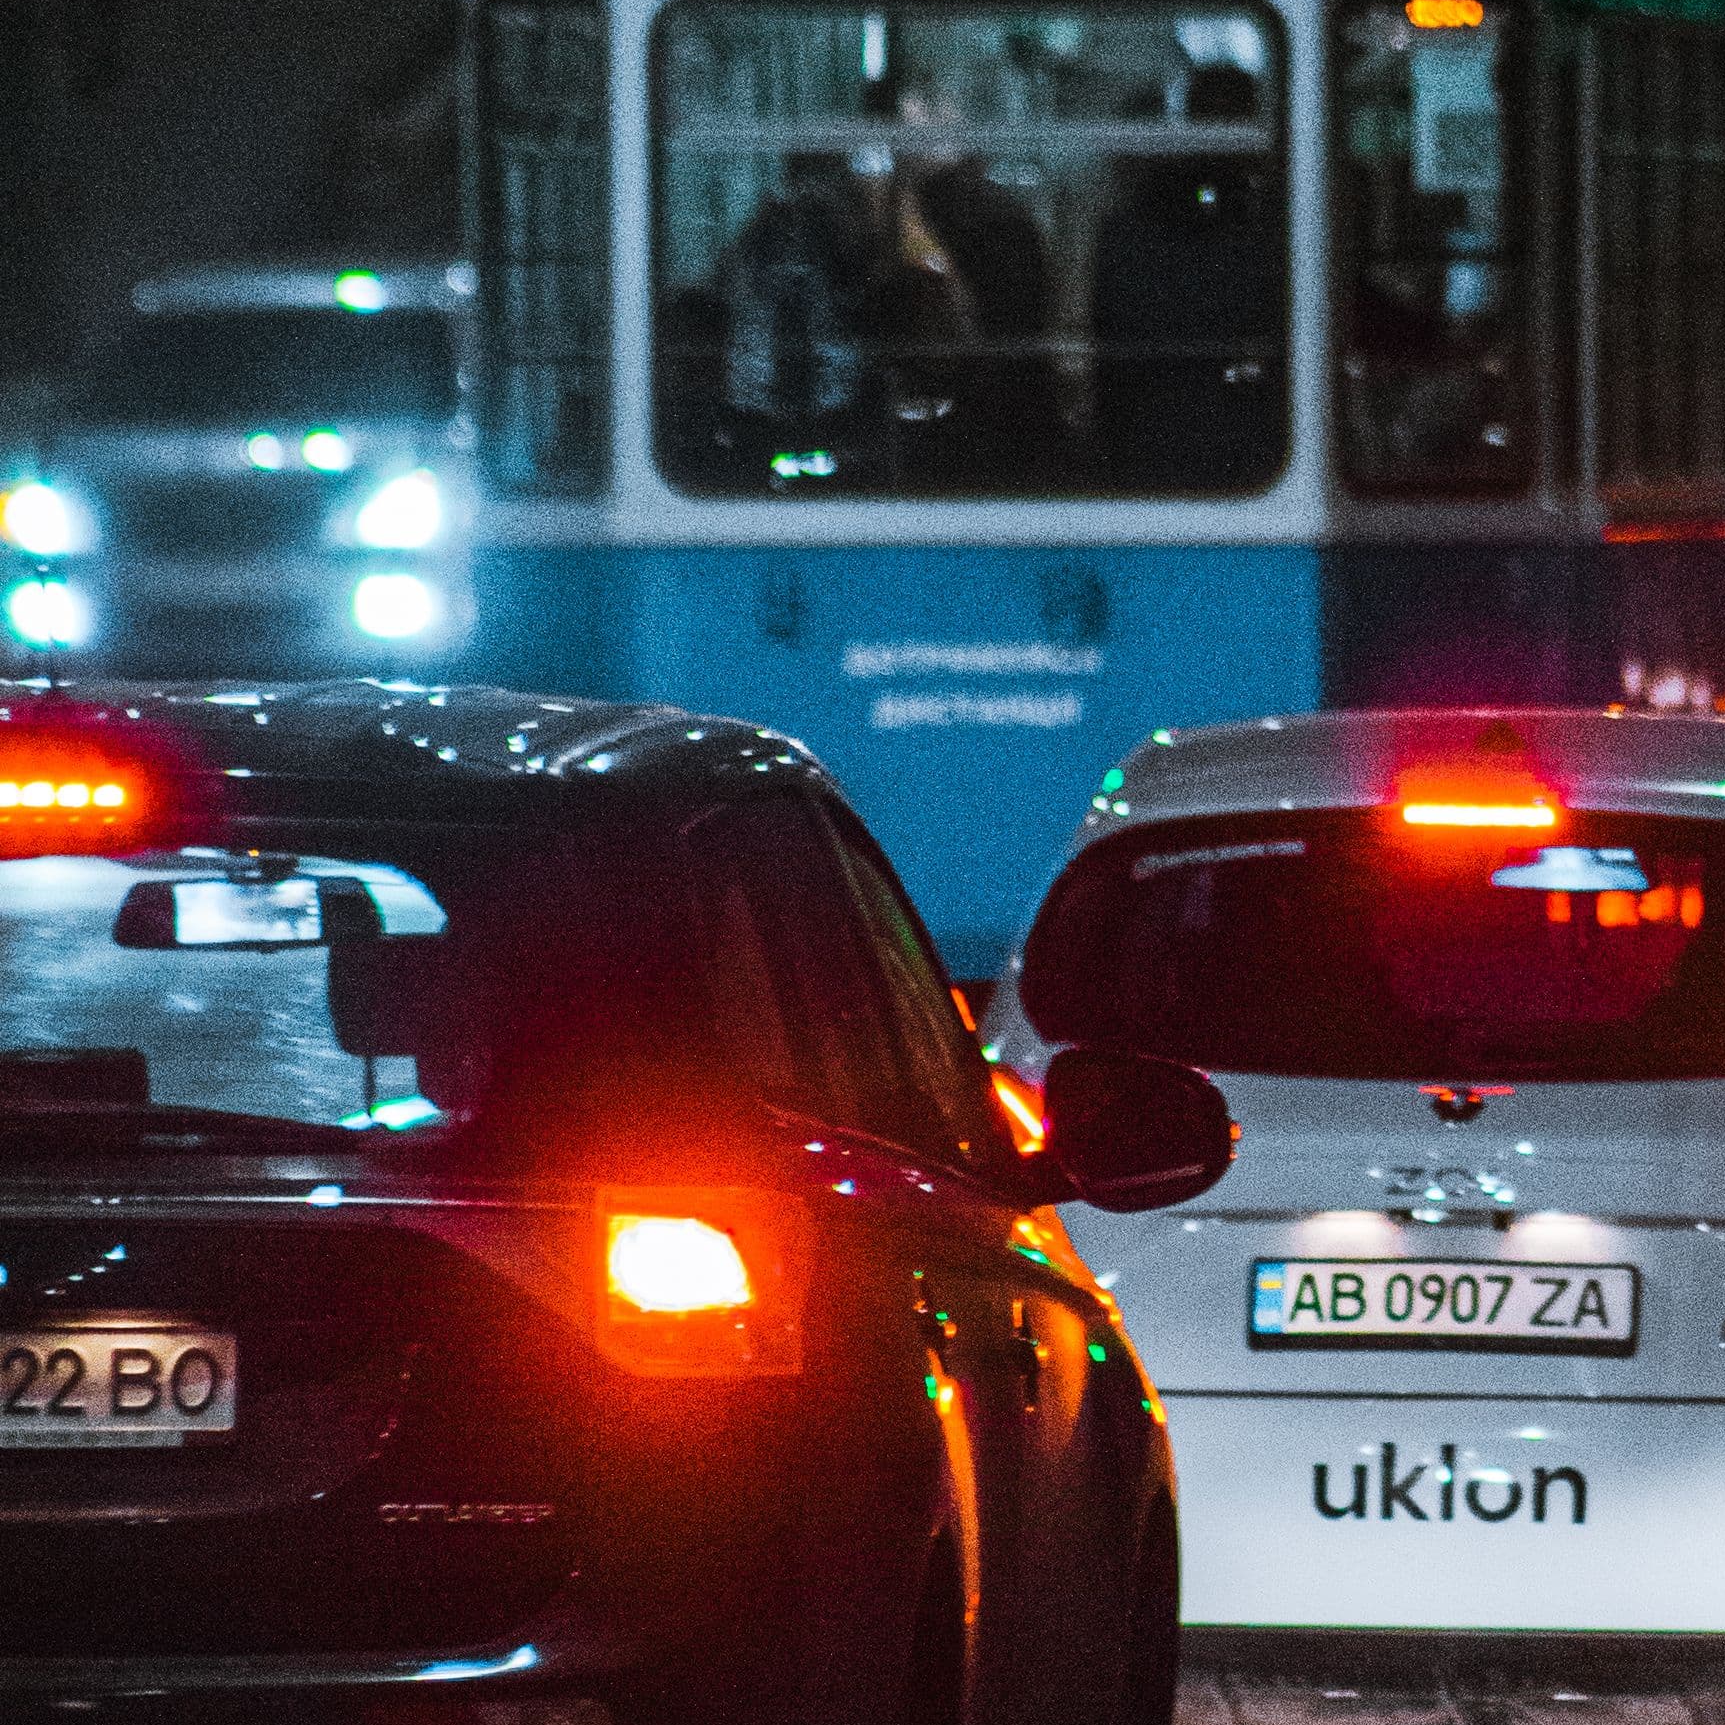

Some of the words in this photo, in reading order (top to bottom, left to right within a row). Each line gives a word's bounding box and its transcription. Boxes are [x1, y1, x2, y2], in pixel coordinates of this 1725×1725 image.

[1288, 1272, 1368, 1323] AB
[1384, 1273, 1515, 1325] 0907
[1530, 1276, 1610, 1330] ZA
[1, 1347, 87, 1416] 22
[110, 1347, 222, 1417] BO
[1311, 1441, 1589, 1525] uklon
